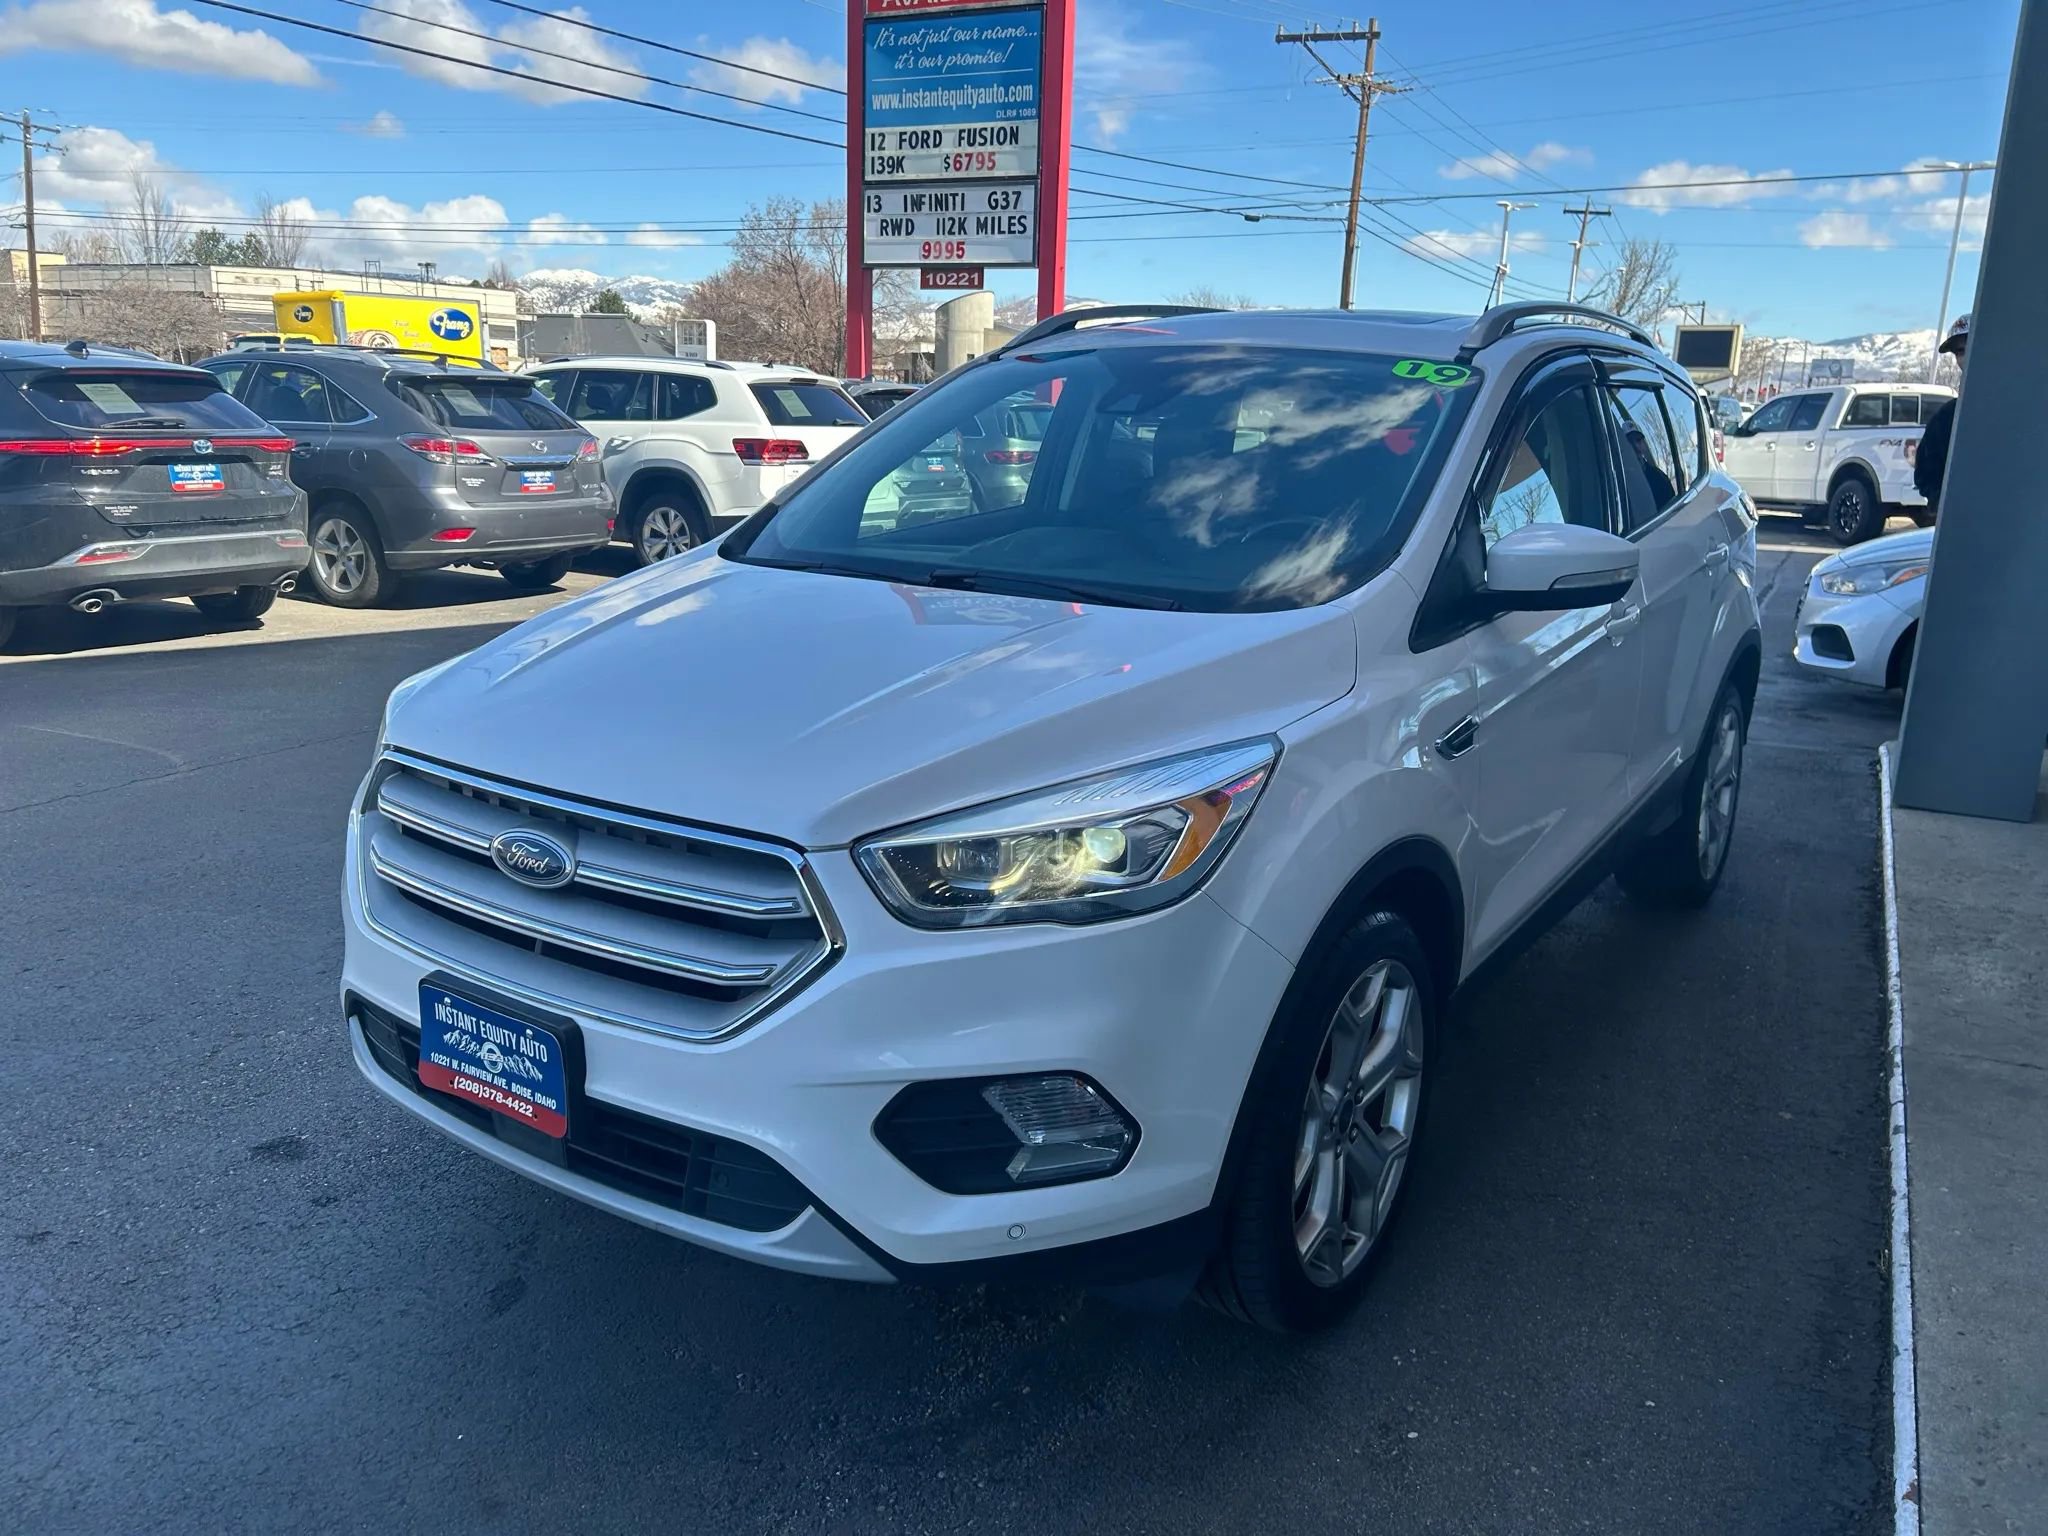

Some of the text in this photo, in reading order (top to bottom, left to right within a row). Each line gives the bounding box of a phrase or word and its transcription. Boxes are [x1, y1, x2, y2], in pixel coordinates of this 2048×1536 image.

[873, 25, 1038, 53] It's not just our name...
[894, 42, 1015, 74] it's our promise!
[872, 83, 1034, 112] www.instantequityauto.com
[870, 126, 1020, 151] 12 FORD FUSION
[870, 151, 997, 175] 139K $6795
[866, 190, 1023, 214] 13 INFINITI G37
[879, 215, 1028, 237] RWD 112K MILES
[922, 241, 966, 260] 9995
[925, 272, 980, 286] 10221
[1405, 362, 1468, 383] 19
[506, 841, 550, 875] Ford
[434, 1002, 548, 1063] INSTANT EQUITY AUTO
[430, 1051, 557, 1110] 10221 W. FAIRVIEW AVE. BOISE, IDAHO
[453, 1075, 533, 1117] (208)378-4422
